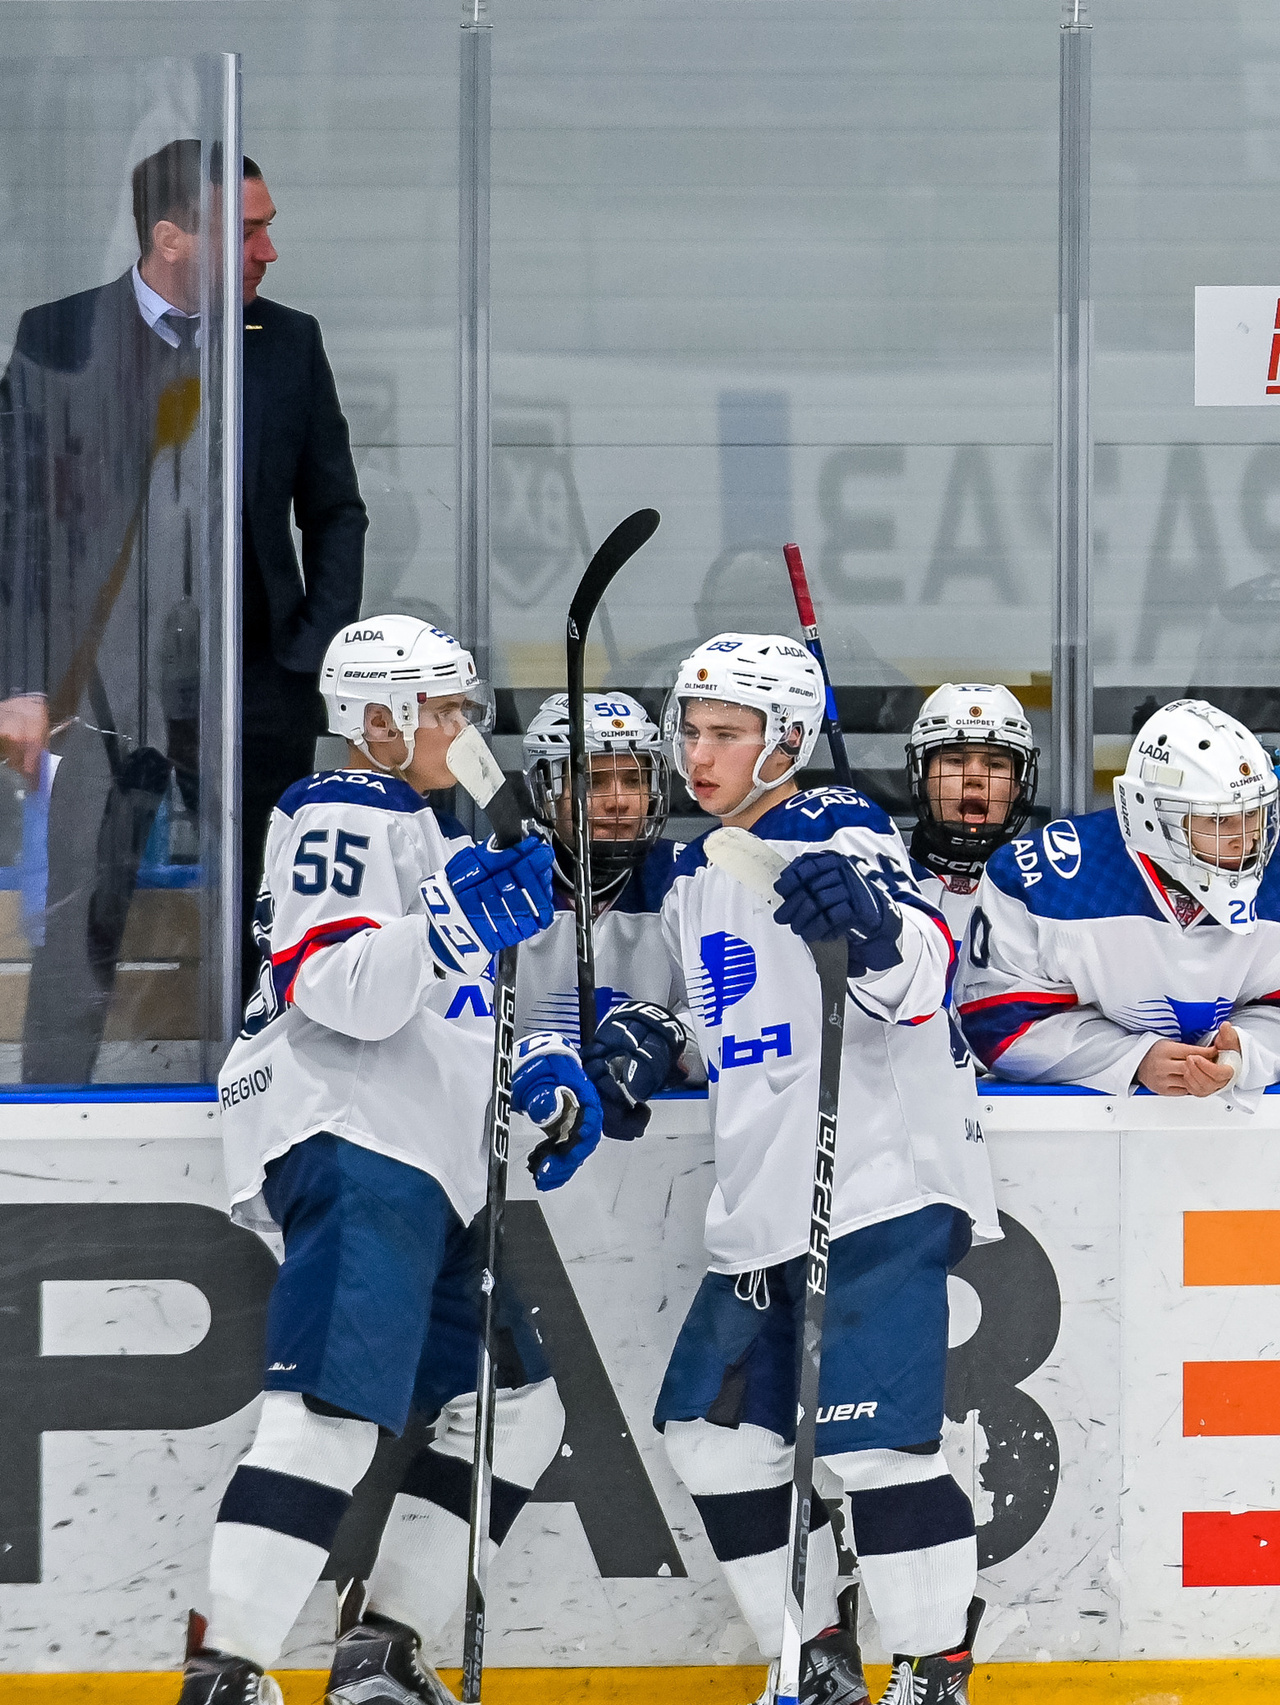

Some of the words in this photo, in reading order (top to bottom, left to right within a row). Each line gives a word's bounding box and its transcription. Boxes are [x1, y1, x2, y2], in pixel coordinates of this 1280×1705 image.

[344, 630, 385, 643] LADA
[776, 646, 808, 659] LADA
[344, 670, 388, 679] BAUER
[685, 683, 718, 691] OLIMPBET
[789, 686, 814, 698] BAUER
[555, 697, 569, 708] LA
[594, 702, 631, 717] 50
[600, 730, 639, 738] OLIMPBET
[1138, 741, 1171, 764] LADA
[307, 773, 387, 795] LADA
[1230, 773, 1264, 789] OLIMPBET
[800, 793, 870, 820] LADA
[1118, 784, 1133, 838] BAUER
[292, 828, 371, 898] 55
[1011, 838, 1043, 888] ADA
[595, 1001, 686, 1043] UER
[221, 1063, 273, 1107] REGION
[797, 1400, 878, 1425] UER
